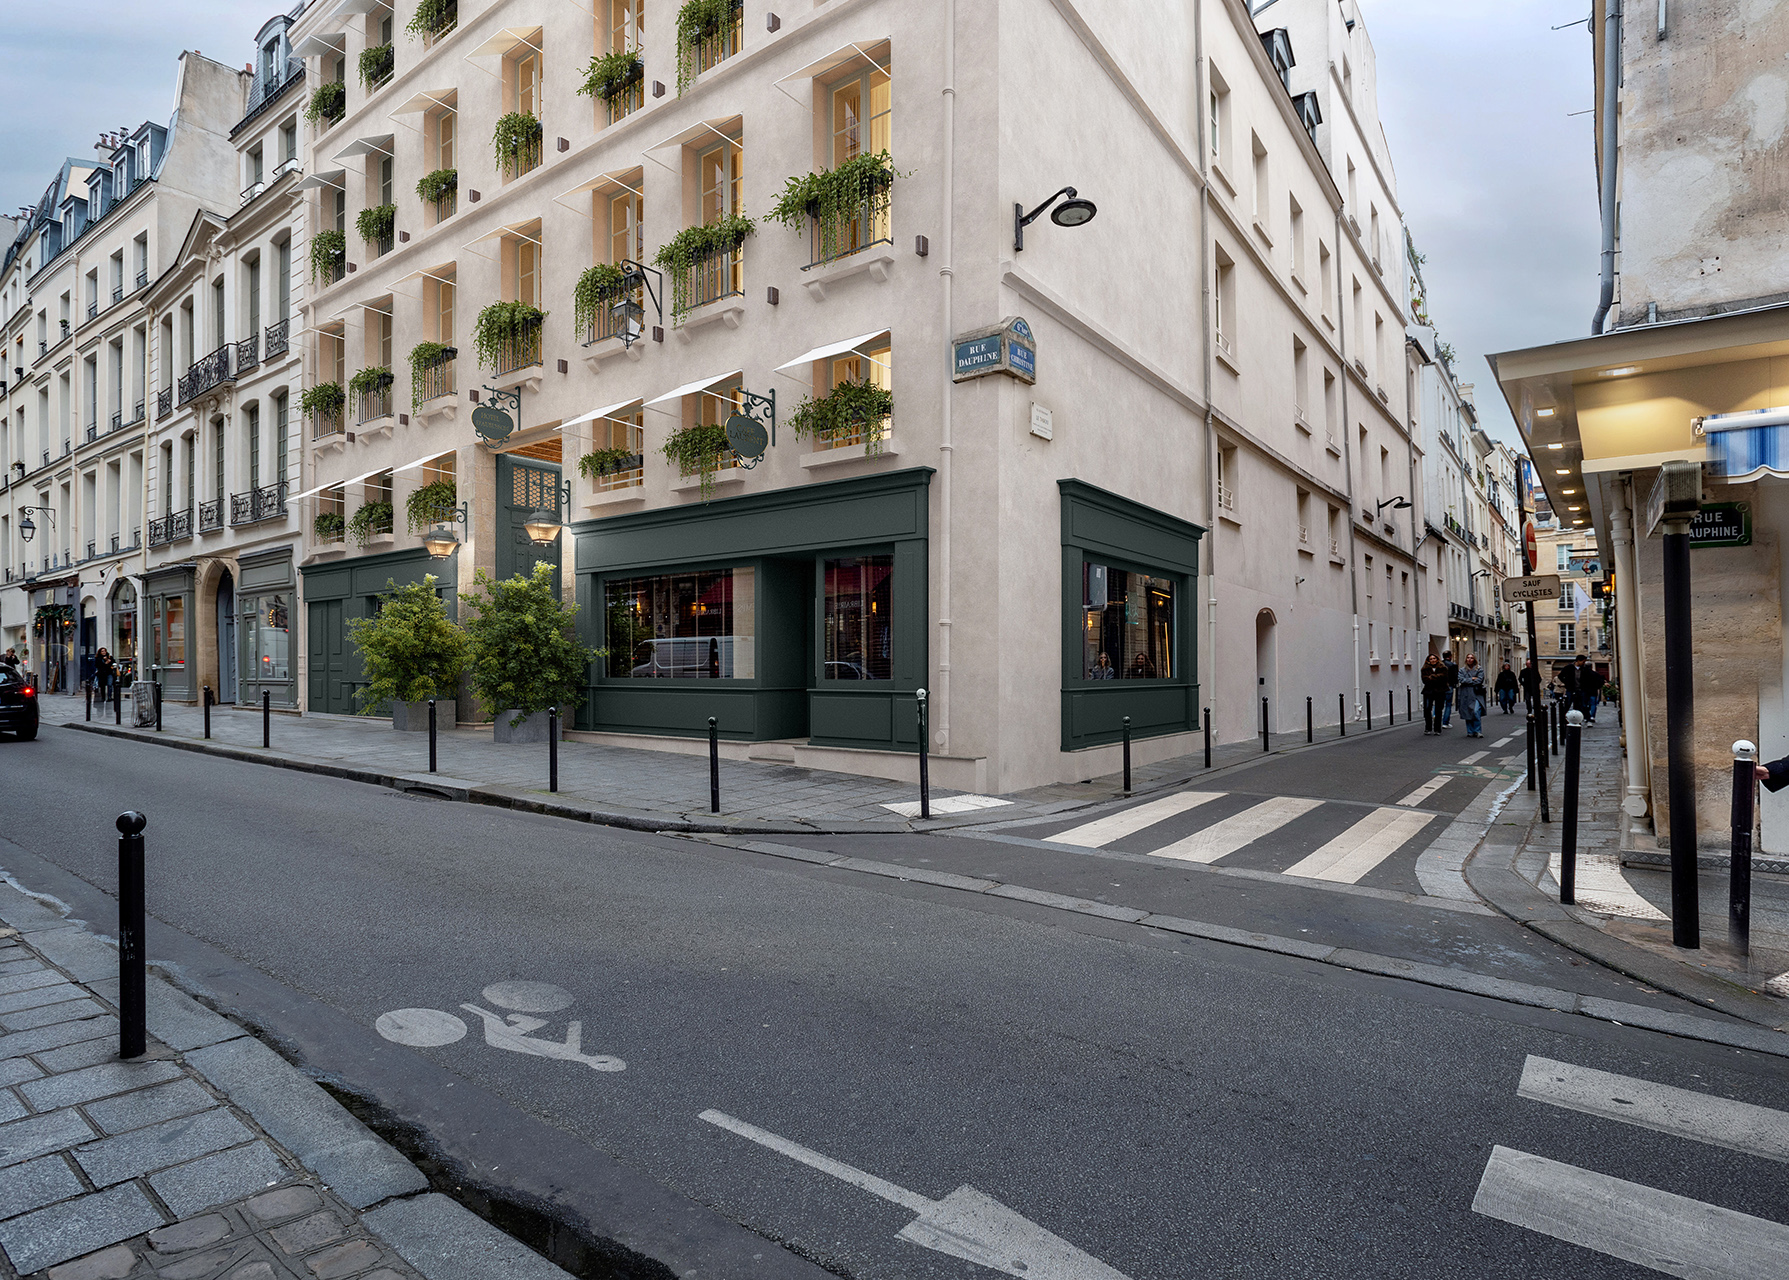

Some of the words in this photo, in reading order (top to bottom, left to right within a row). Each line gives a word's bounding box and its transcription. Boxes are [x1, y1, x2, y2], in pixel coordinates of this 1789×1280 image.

[969, 343, 987, 355] RUE
[1017, 348, 1028, 360] RUE
[958, 351, 998, 368] DAUPHINE
[1693, 512, 1723, 524] RUE
[1689, 525, 1739, 538] AUPHINE
[1522, 579, 1541, 588] SAUF
[1512, 588, 1553, 598] CYCLISTES
